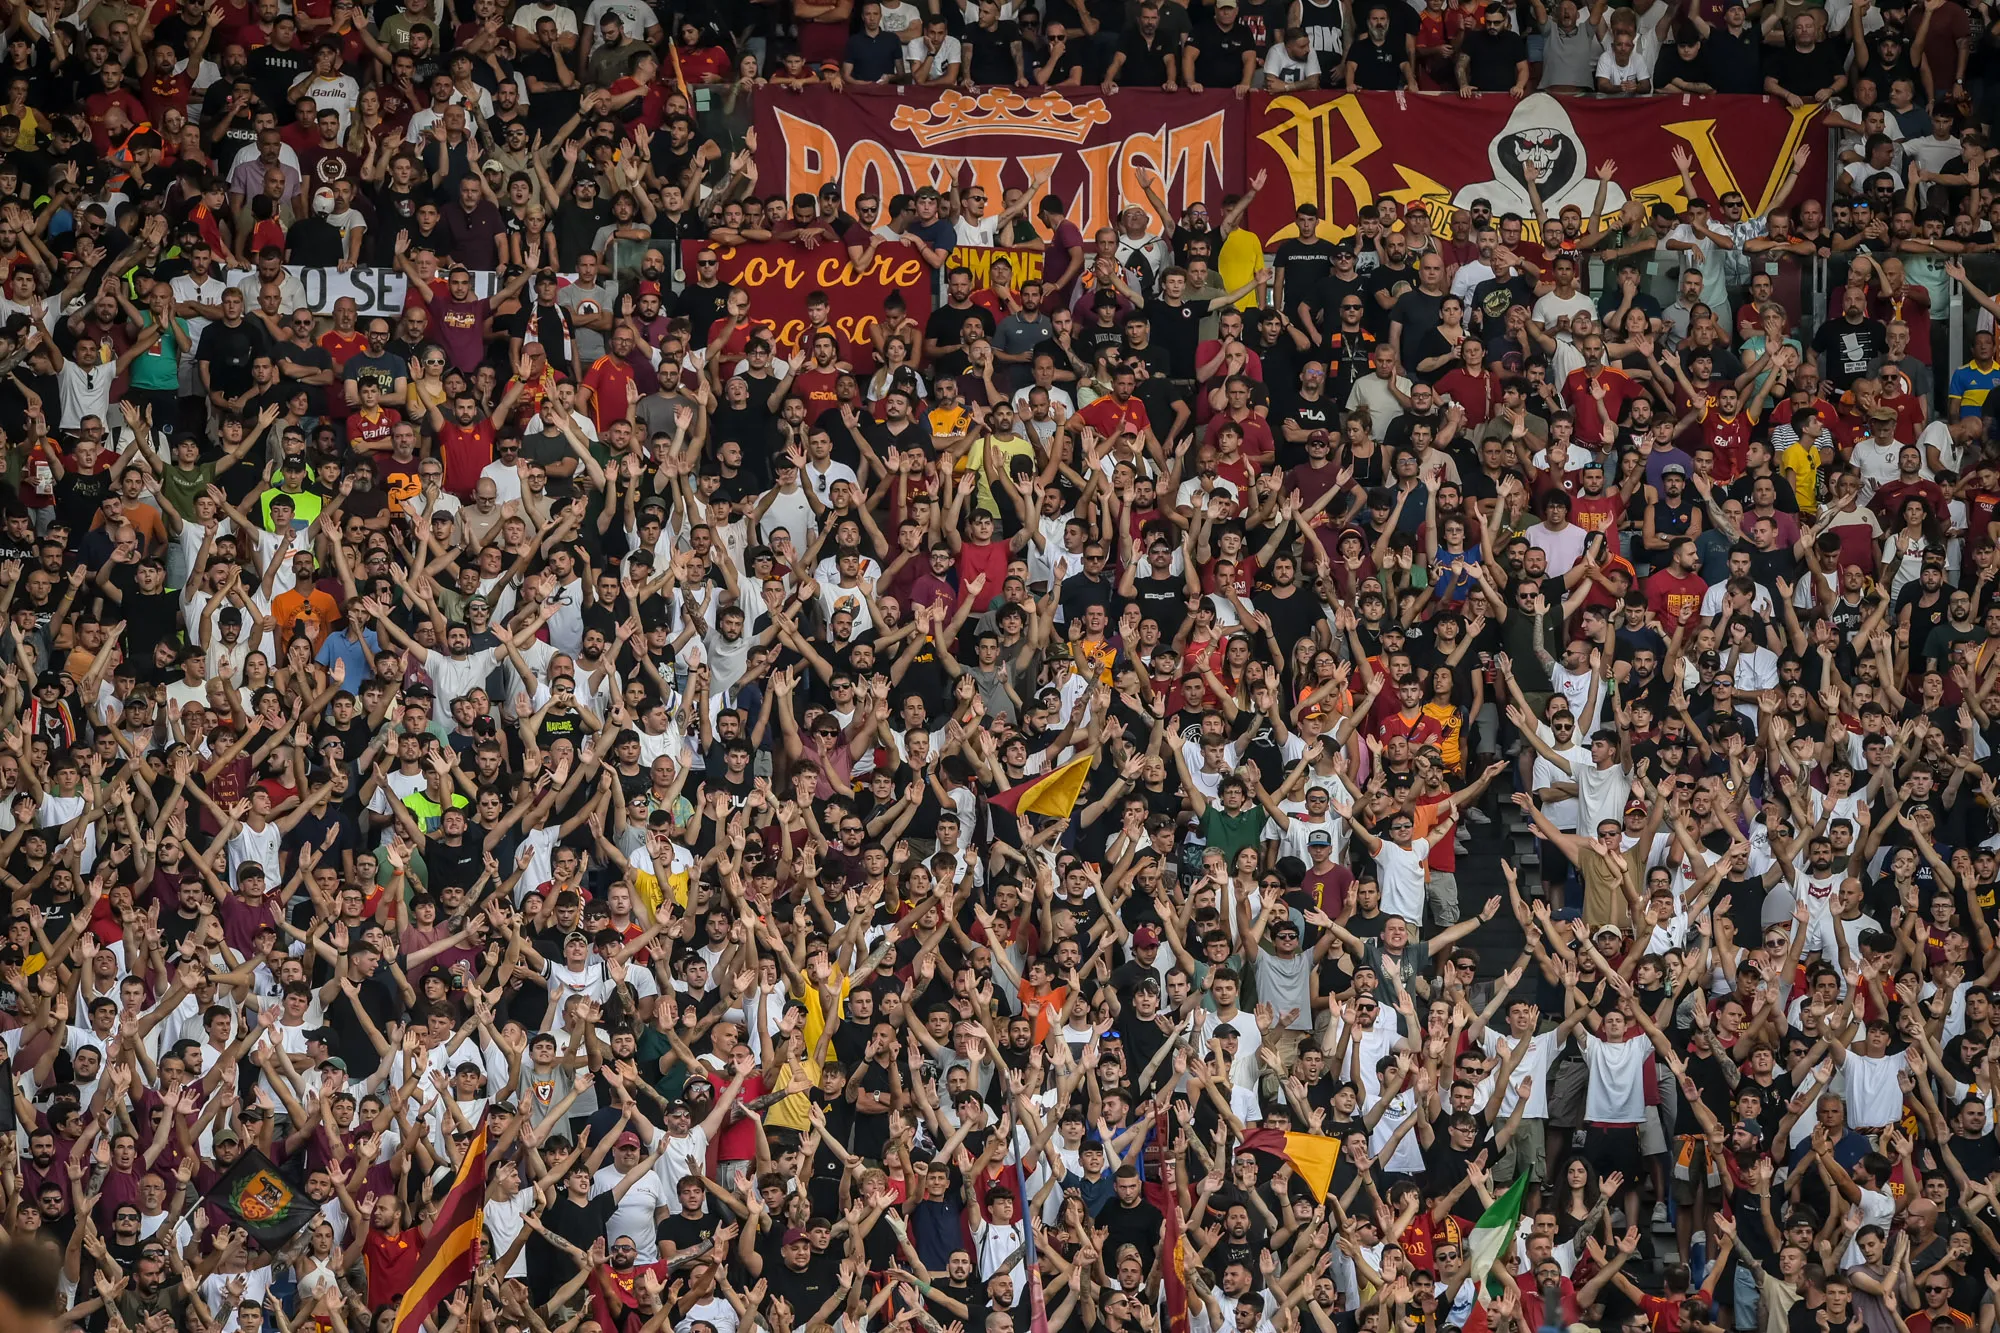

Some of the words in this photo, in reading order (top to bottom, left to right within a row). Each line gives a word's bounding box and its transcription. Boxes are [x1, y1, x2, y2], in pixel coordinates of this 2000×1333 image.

[312, 88, 347, 100] Barilla
[816, 254, 922, 289] core
[1299, 408, 1327, 422] FILA
